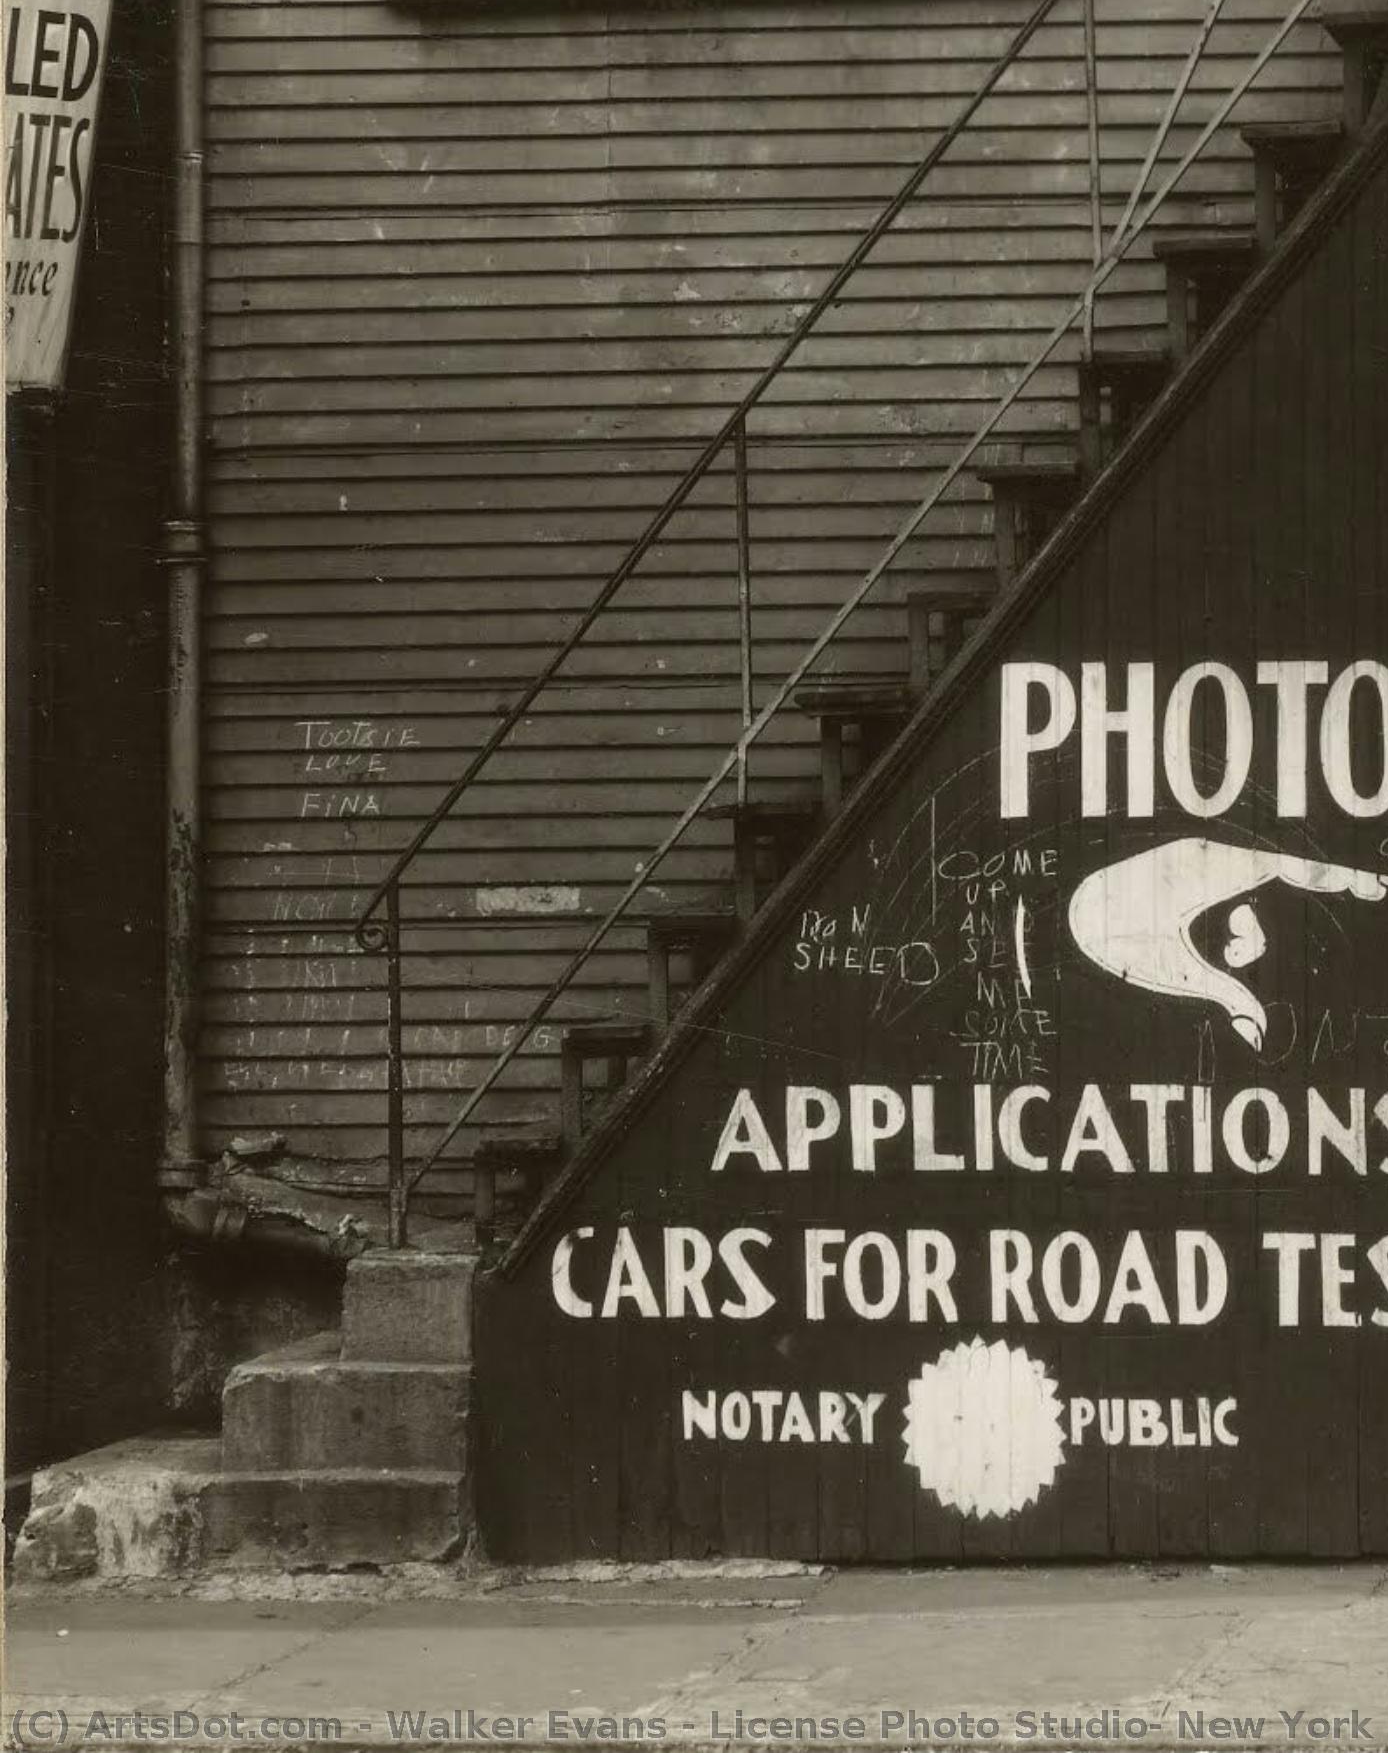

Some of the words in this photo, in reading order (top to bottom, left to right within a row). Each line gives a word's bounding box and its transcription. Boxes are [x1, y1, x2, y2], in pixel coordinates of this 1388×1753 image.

[939, 849, 1058, 880] COME
[966, 879, 1007, 906] UP
[551, 1225, 776, 1321] CARS
[804, 1227, 959, 1323] FOR
[989, 1229, 1230, 1326] ROAD
[681, 1388, 887, 1445] NOTARY
[1069, 1396, 1240, 1448] PUBLIC
